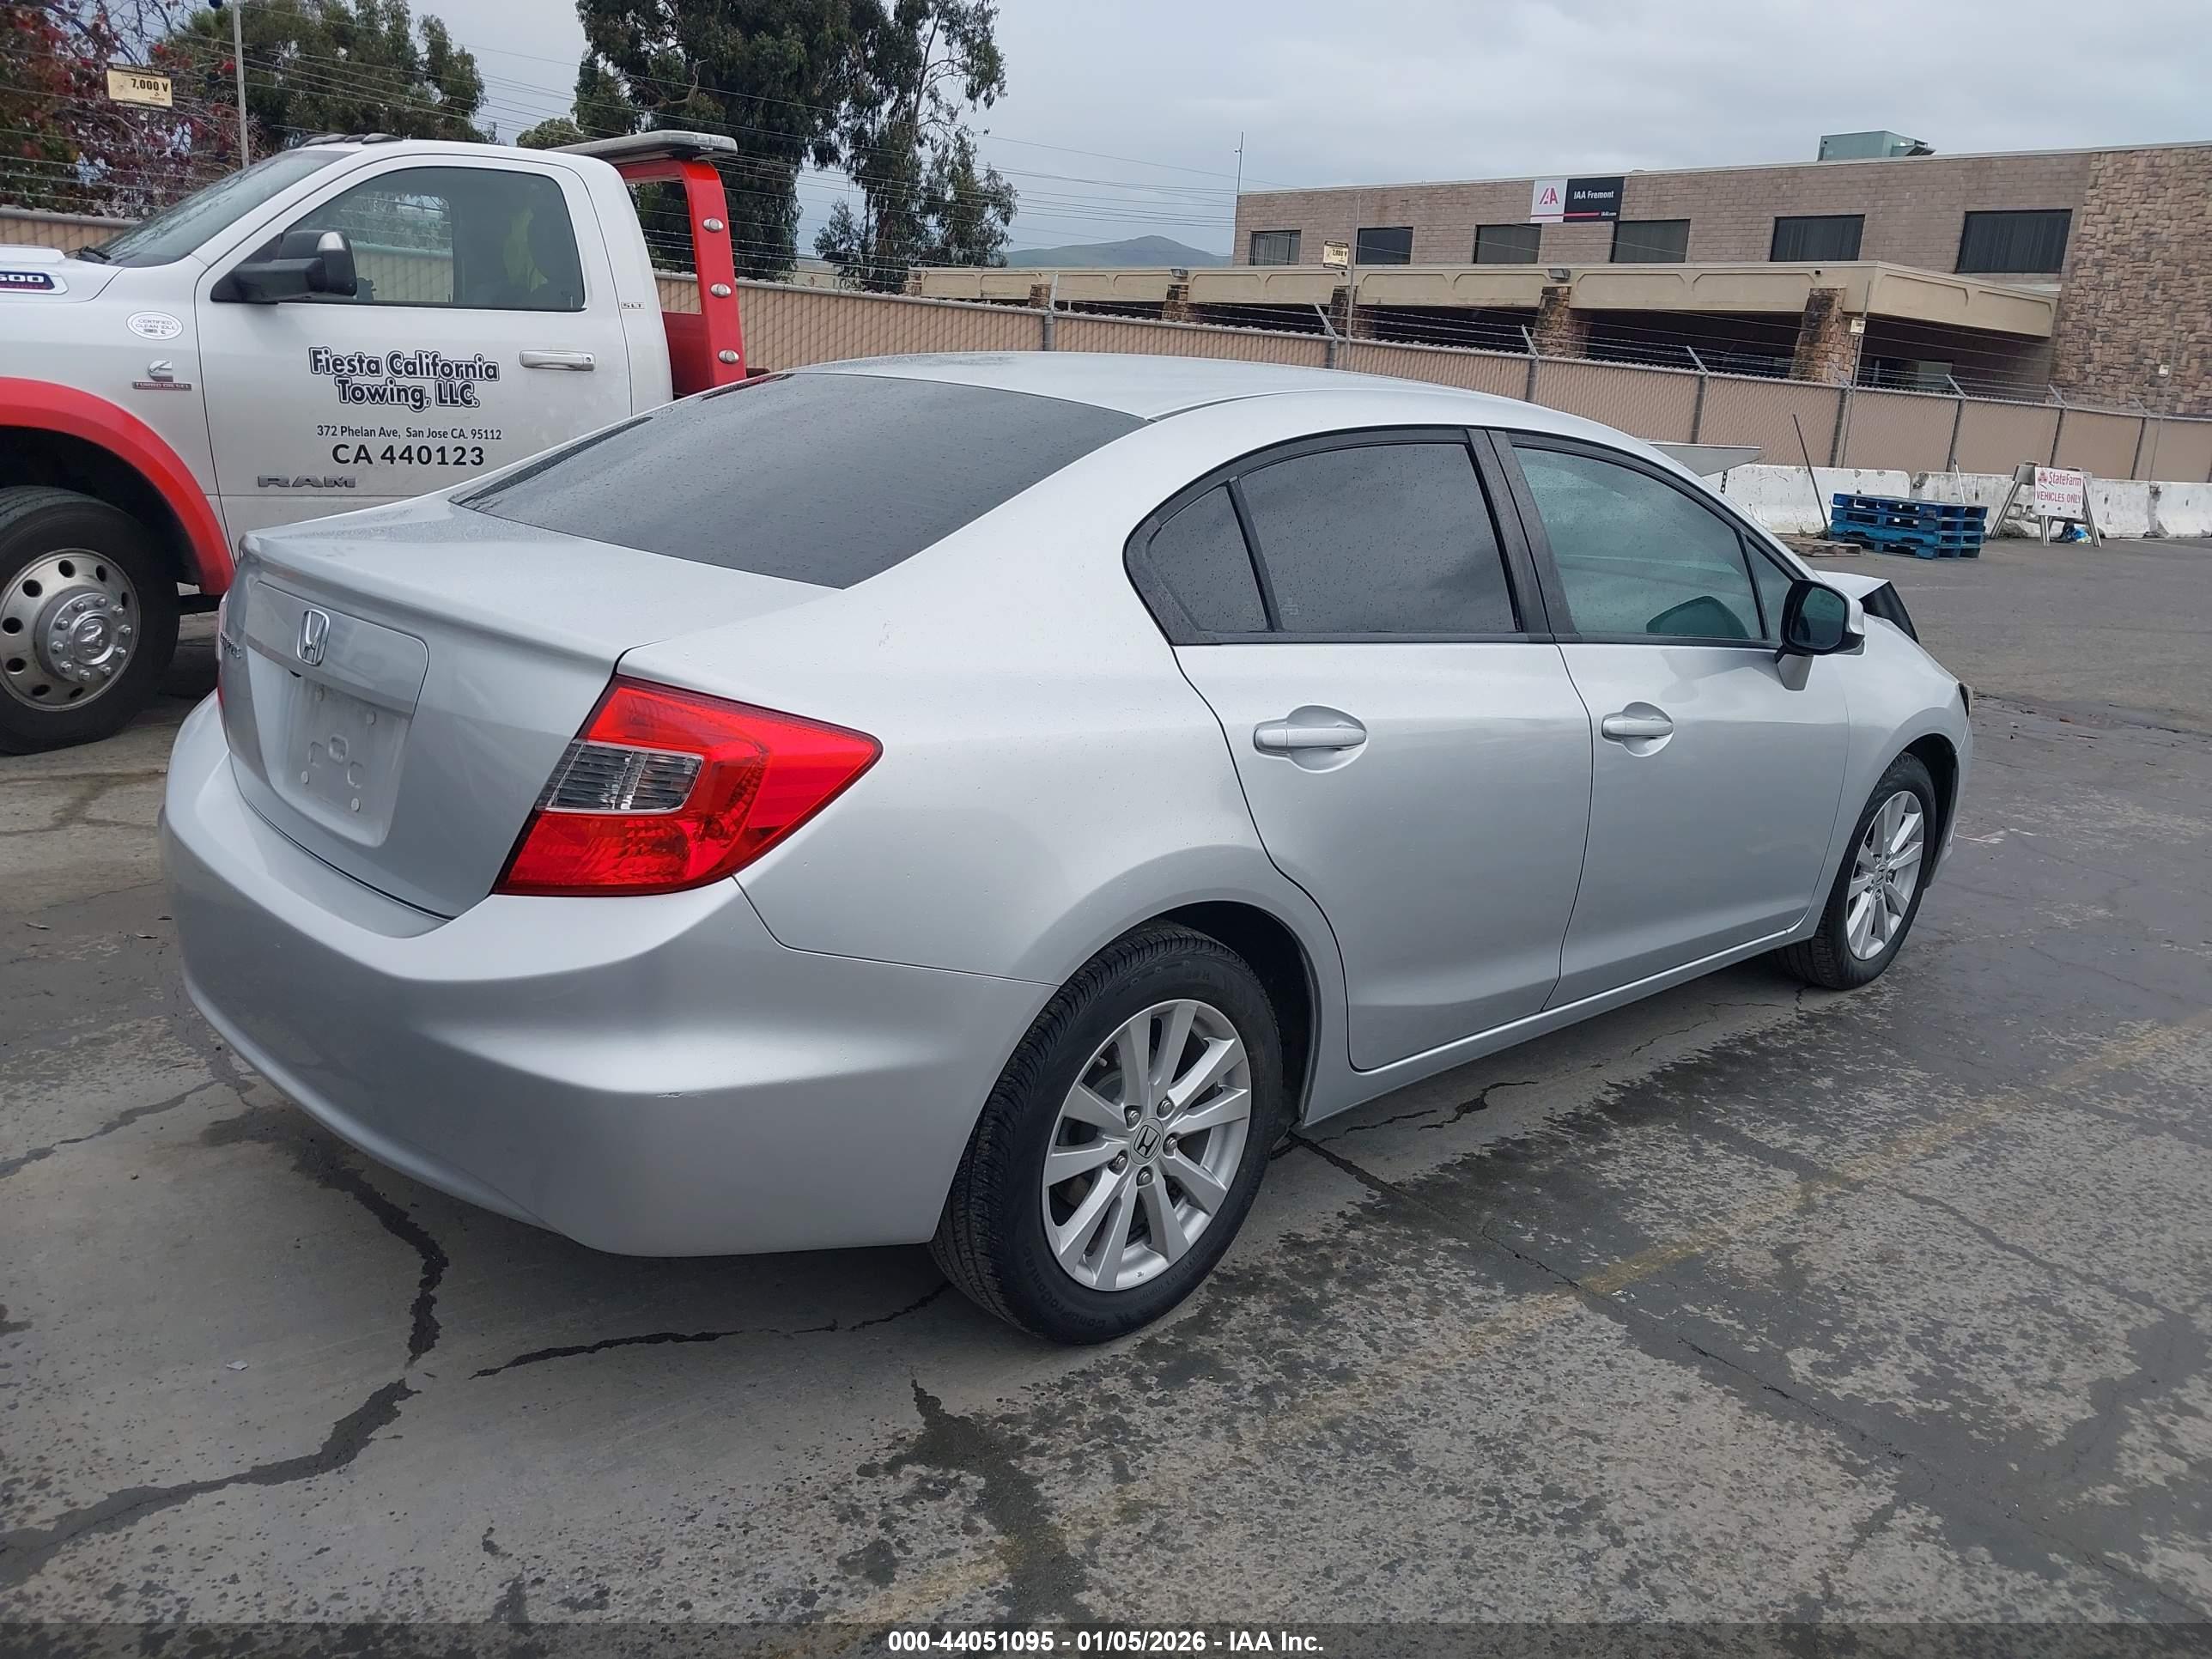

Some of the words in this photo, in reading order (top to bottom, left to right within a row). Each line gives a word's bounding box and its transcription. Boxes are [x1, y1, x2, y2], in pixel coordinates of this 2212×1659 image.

[131, 78, 160, 91] 7,000
[161, 82, 168, 92] V
[1573, 191, 1586, 200] IAA
[1587, 190, 1614, 199] Fremont
[309, 346, 383, 377] Fiesta
[387, 350, 500, 381] California
[435, 380, 481, 408] LLC.
[317, 425, 337, 436] 372
[340, 426, 376, 438] Phelan
[379, 427, 401, 440] Ave,
[406, 427, 424, 438] San
[427, 428, 448, 439] Jose
[451, 428, 468, 439] CA.
[471, 428, 501, 440] 95112
[331, 444, 374, 465] CA
[380, 445, 484, 466] 440123
[258, 476, 356, 488] RAM
[2036, 491, 2065, 502] VEHICLES
[2066, 493, 2082, 504] ONLY
